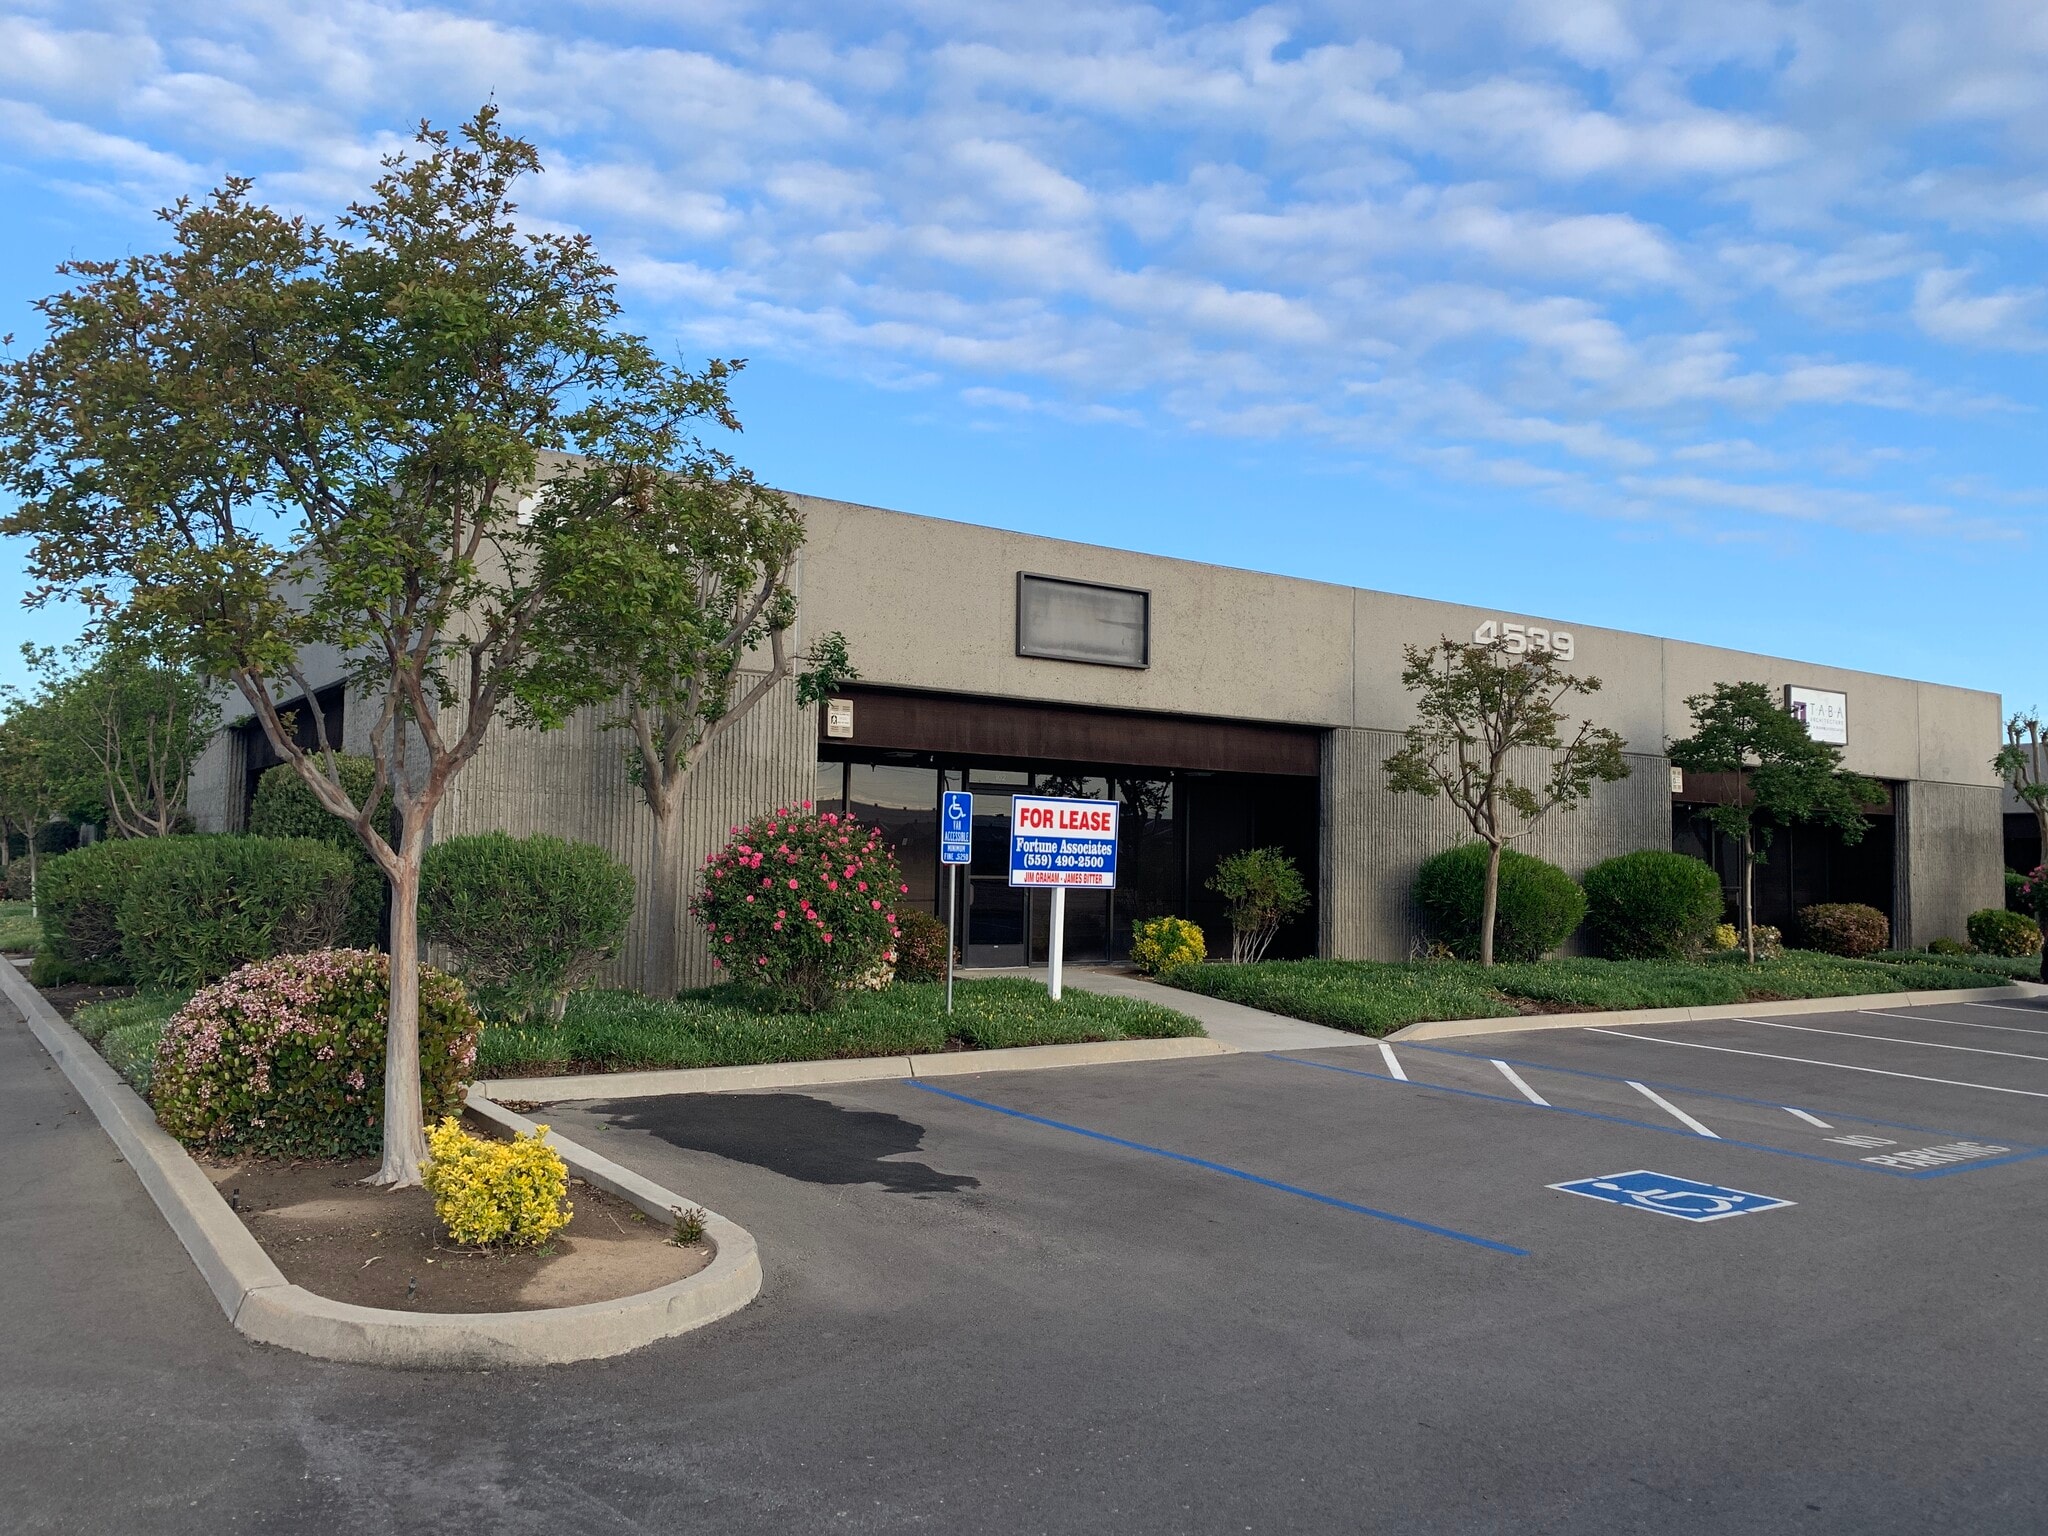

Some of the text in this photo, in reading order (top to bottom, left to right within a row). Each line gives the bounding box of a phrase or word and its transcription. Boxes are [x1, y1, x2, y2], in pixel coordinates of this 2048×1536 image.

[1472, 619, 1575, 661] 4539
[1809, 702, 1844, 719] TABA
[953, 820, 962, 831] VAN
[1020, 807, 1111, 831] FOR LEASE
[944, 831, 969, 842] ACCESSIBLE
[1016, 837, 1113, 856] Fortune Associates
[943, 852, 954, 861] FINE
[1023, 853, 1104, 869] (559) 490-2500
[1024, 871, 1035, 883] JIM
[1036, 872, 1060, 884] GRAHAM
[1064, 872, 1083, 884] JAMES
[1083, 873, 1103, 885] BITTER
[1822, 1134, 1898, 1149] NO
[1859, 1141, 2011, 1170] PARKING
